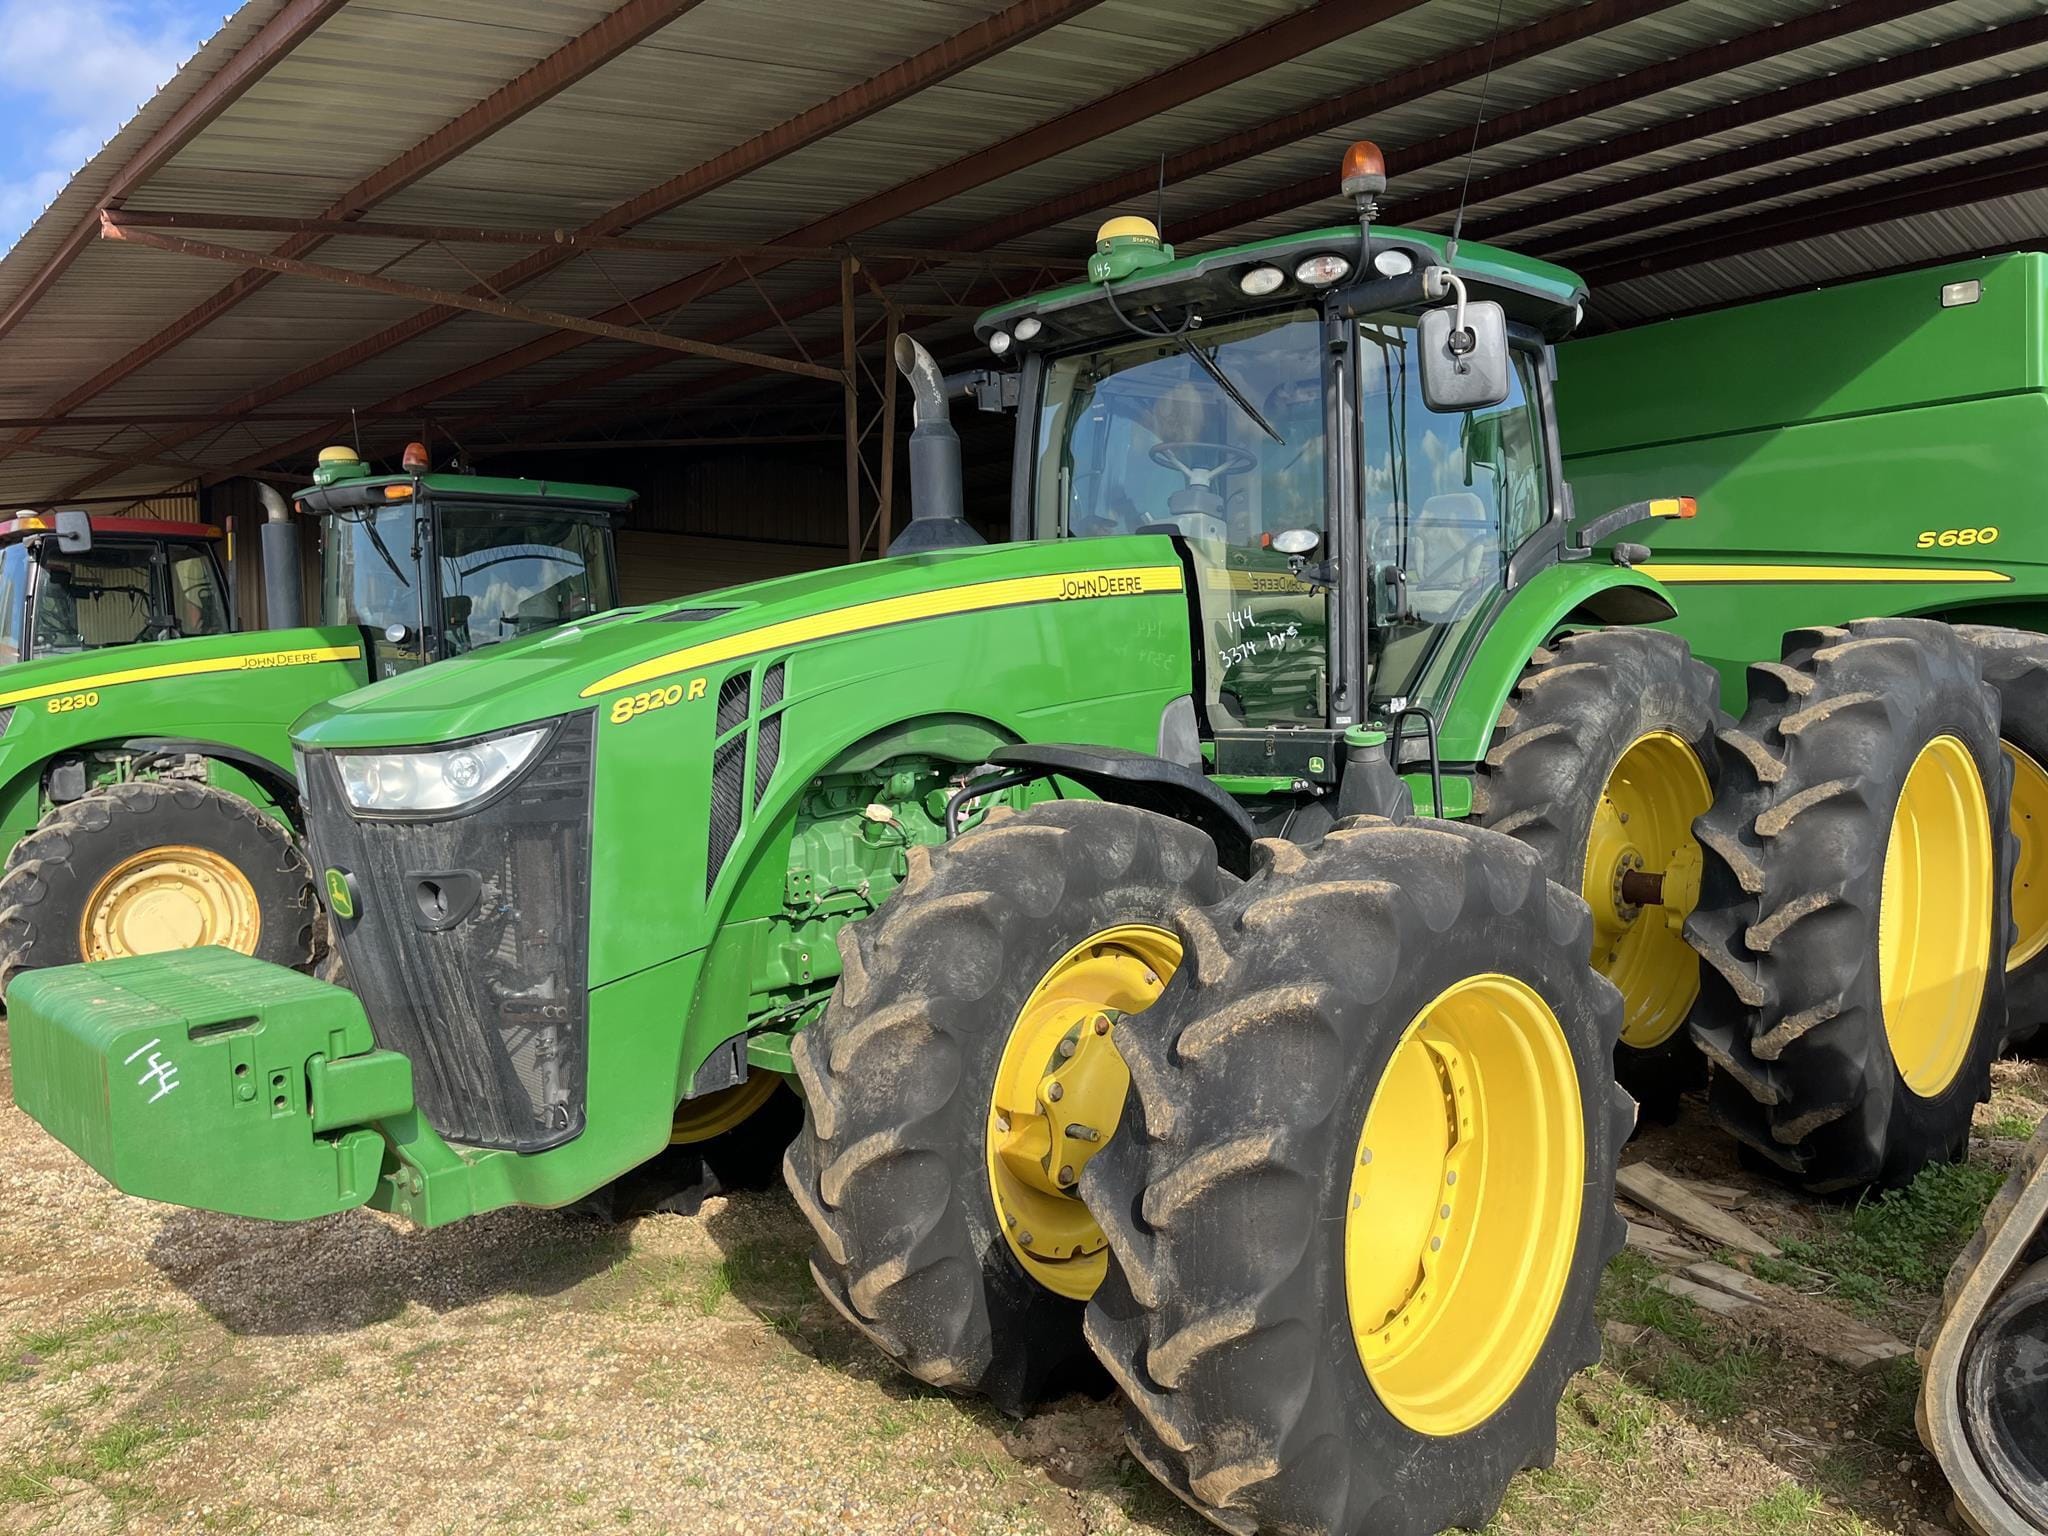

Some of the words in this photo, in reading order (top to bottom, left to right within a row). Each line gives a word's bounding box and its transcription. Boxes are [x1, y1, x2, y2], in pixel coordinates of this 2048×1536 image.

[1094, 262, 1111, 278] 145
[1916, 526, 1999, 549] S680
[1059, 578, 1097, 597] JOHN
[1098, 575, 1142, 592] DEERE
[1226, 605, 1256, 633] 144
[241, 656, 275, 668] JOHN
[276, 653, 318, 664] DEERE
[48, 692, 99, 714] 8230
[610, 684, 683, 724] 8320
